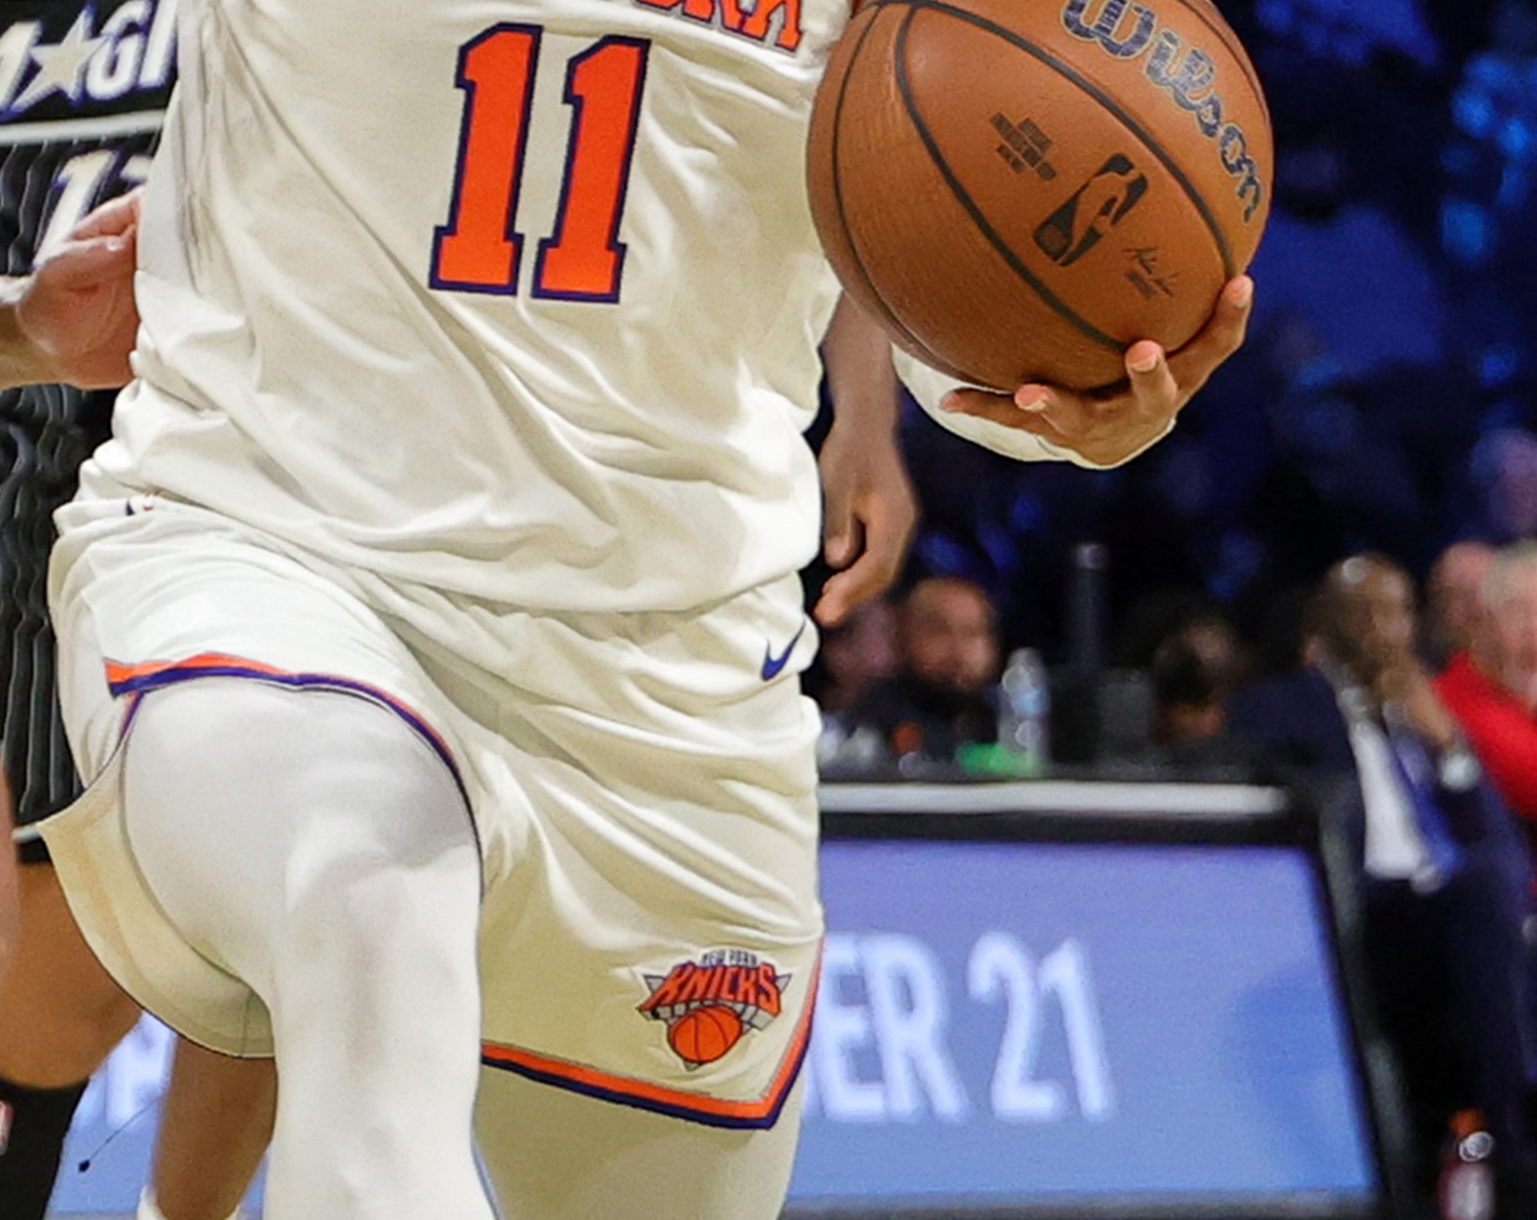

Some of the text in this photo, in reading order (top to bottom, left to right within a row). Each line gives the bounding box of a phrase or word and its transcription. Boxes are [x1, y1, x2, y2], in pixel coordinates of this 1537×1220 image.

[428, 21, 652, 304] 11
[636, 960, 782, 1018] KNICKS
[801, 930, 1117, 1124] ER 21
